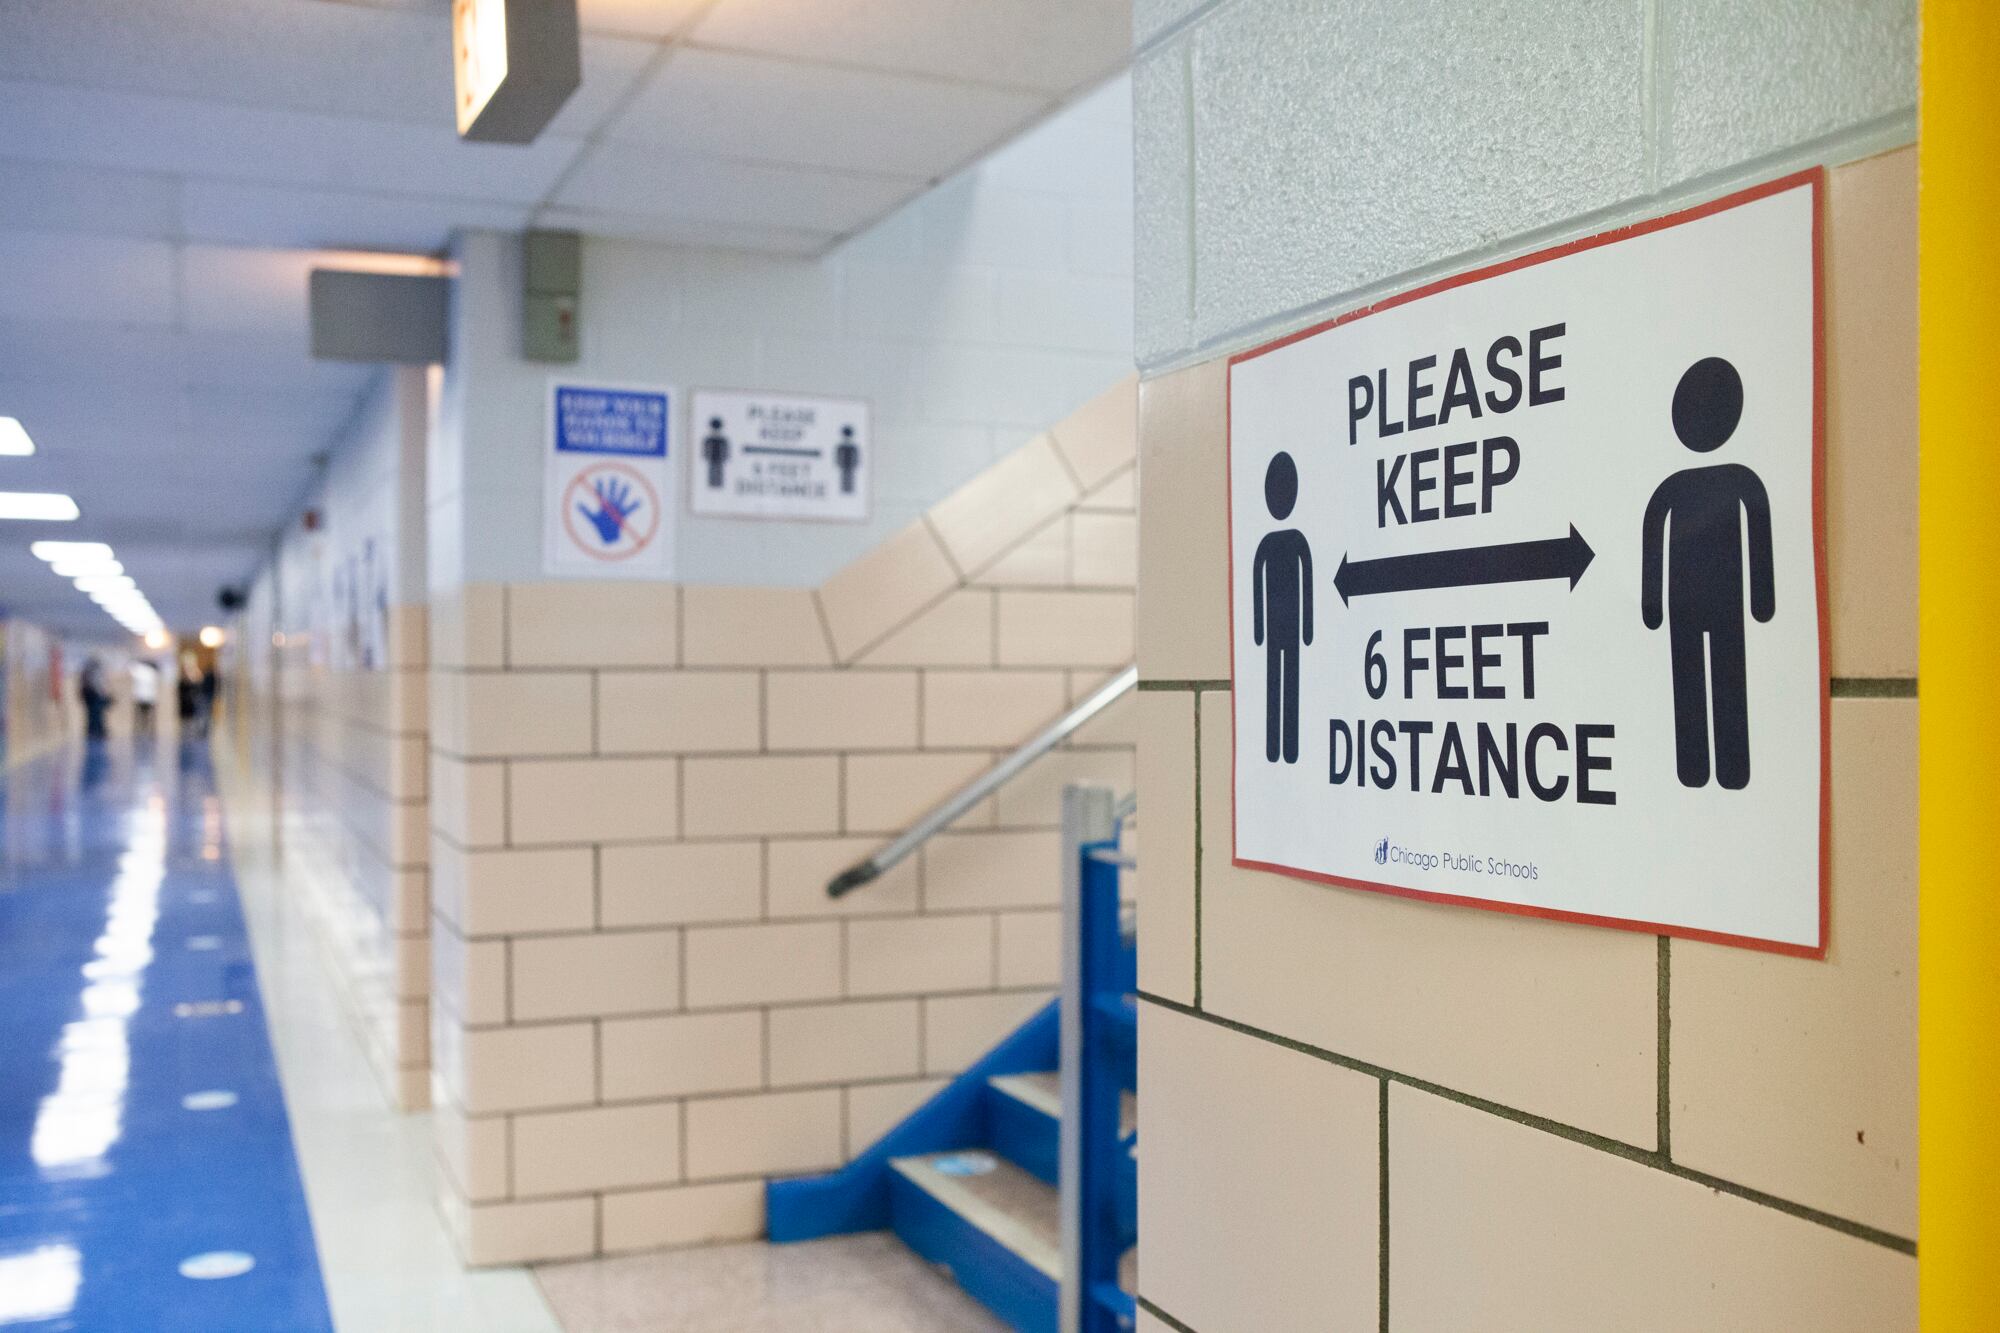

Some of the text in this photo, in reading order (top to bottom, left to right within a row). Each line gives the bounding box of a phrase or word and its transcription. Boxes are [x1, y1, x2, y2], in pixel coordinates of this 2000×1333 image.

[1349, 323, 1566, 446] PLEASE
[1377, 436, 1521, 529] KEEP
[1365, 622, 1550, 700] 6 FEET
[1330, 719, 1617, 806] DISTANCE
[1390, 846, 1539, 880] Chicago Public Schools
